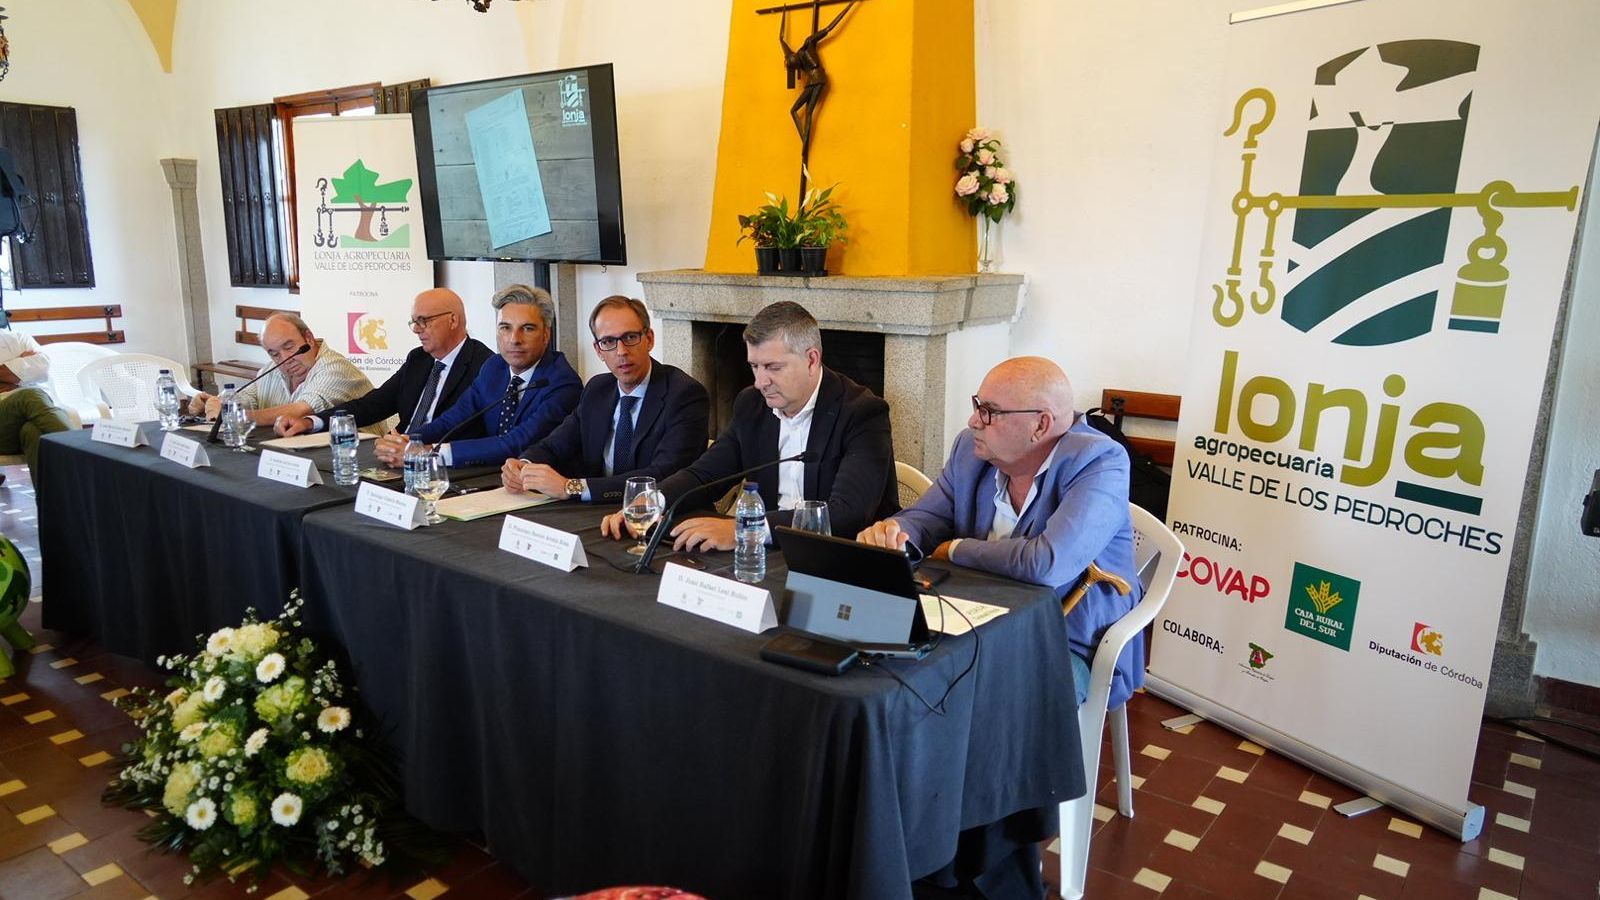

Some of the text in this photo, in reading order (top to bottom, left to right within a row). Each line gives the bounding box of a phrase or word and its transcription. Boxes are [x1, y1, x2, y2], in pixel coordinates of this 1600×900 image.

[562, 108, 585, 121] lonja
[314, 251, 411, 261] LONJA AGROPECUARIA
[315, 262, 411, 271] VALLE DE LOS PEDROCHES
[375, 356, 407, 365] Córdob
[1214, 350, 1486, 487] lonja
[1194, 434, 1335, 479] agropecuaria
[1187, 459, 1504, 555] VALLE DE LOS PEDROCHES
[1172, 520, 1242, 552] PATROCINA:
[1294, 608, 1345, 631] CAJA RURAL
[1299, 618, 1337, 638] DEL SUR
[1163, 619, 1225, 655] COLABORA:
[1368, 641, 1483, 689] Diputación de Córdoba
